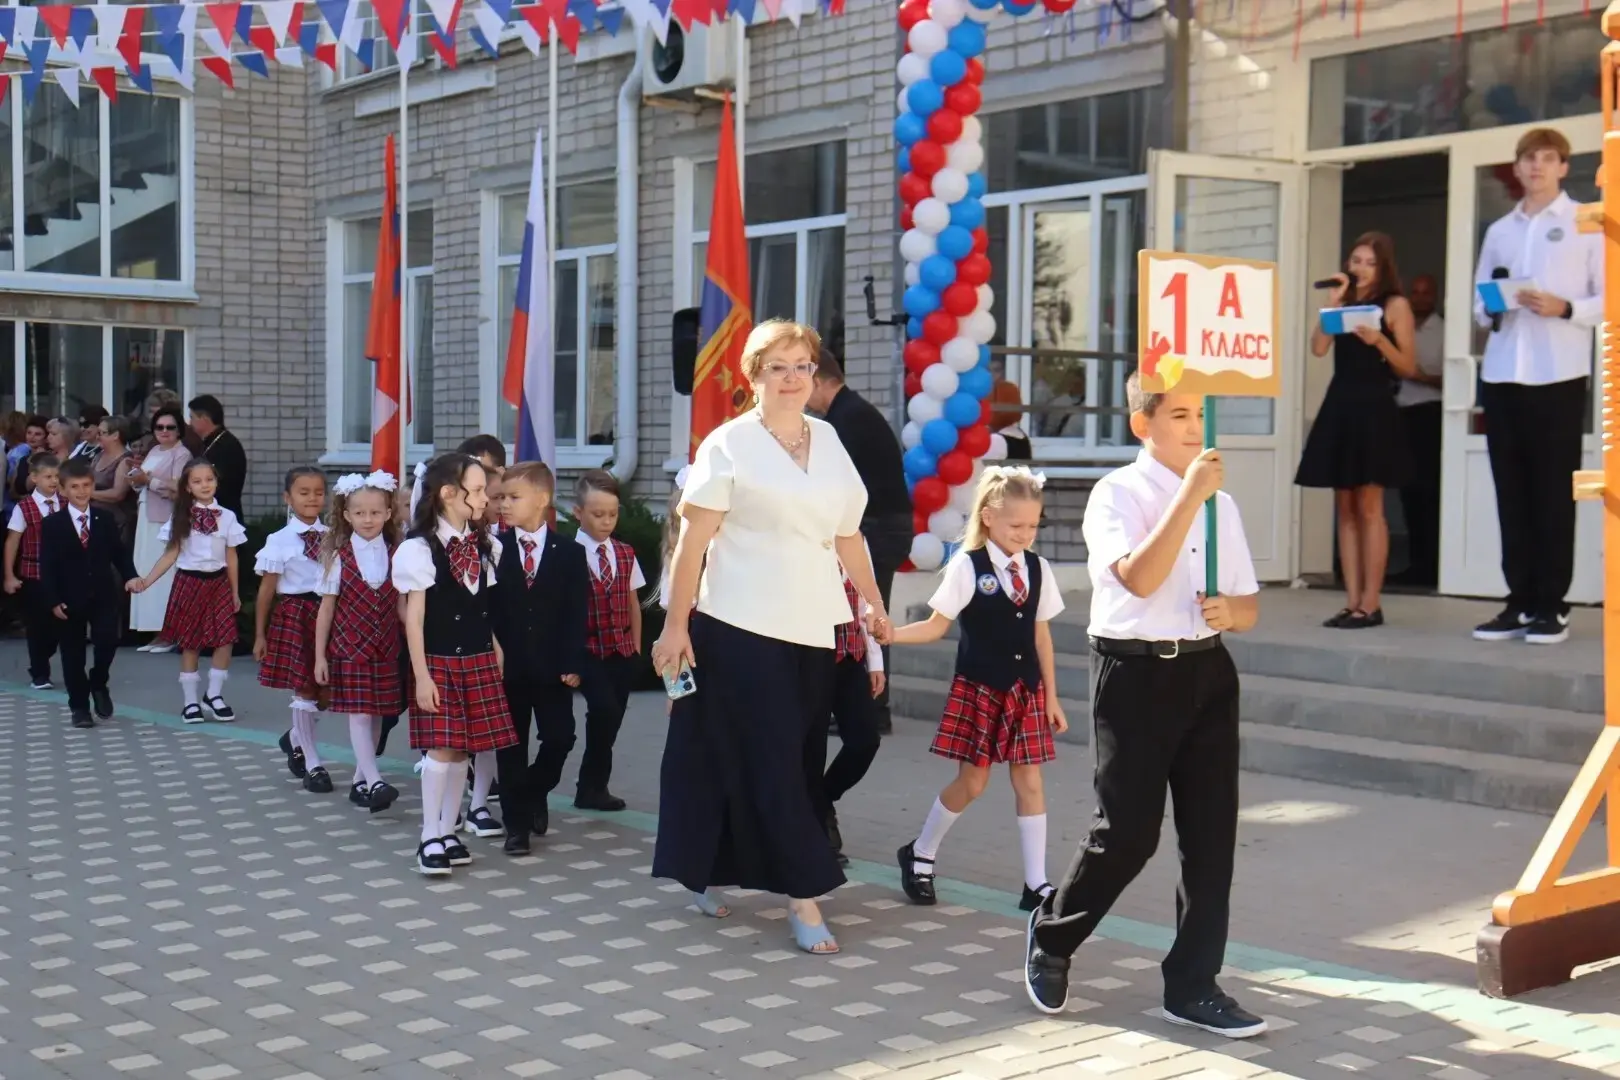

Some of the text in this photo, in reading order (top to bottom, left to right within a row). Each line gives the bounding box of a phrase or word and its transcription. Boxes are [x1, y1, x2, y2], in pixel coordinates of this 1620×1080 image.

[1161, 272, 1243, 355] 1 А
[1201, 329, 1269, 360] КЛАСС
